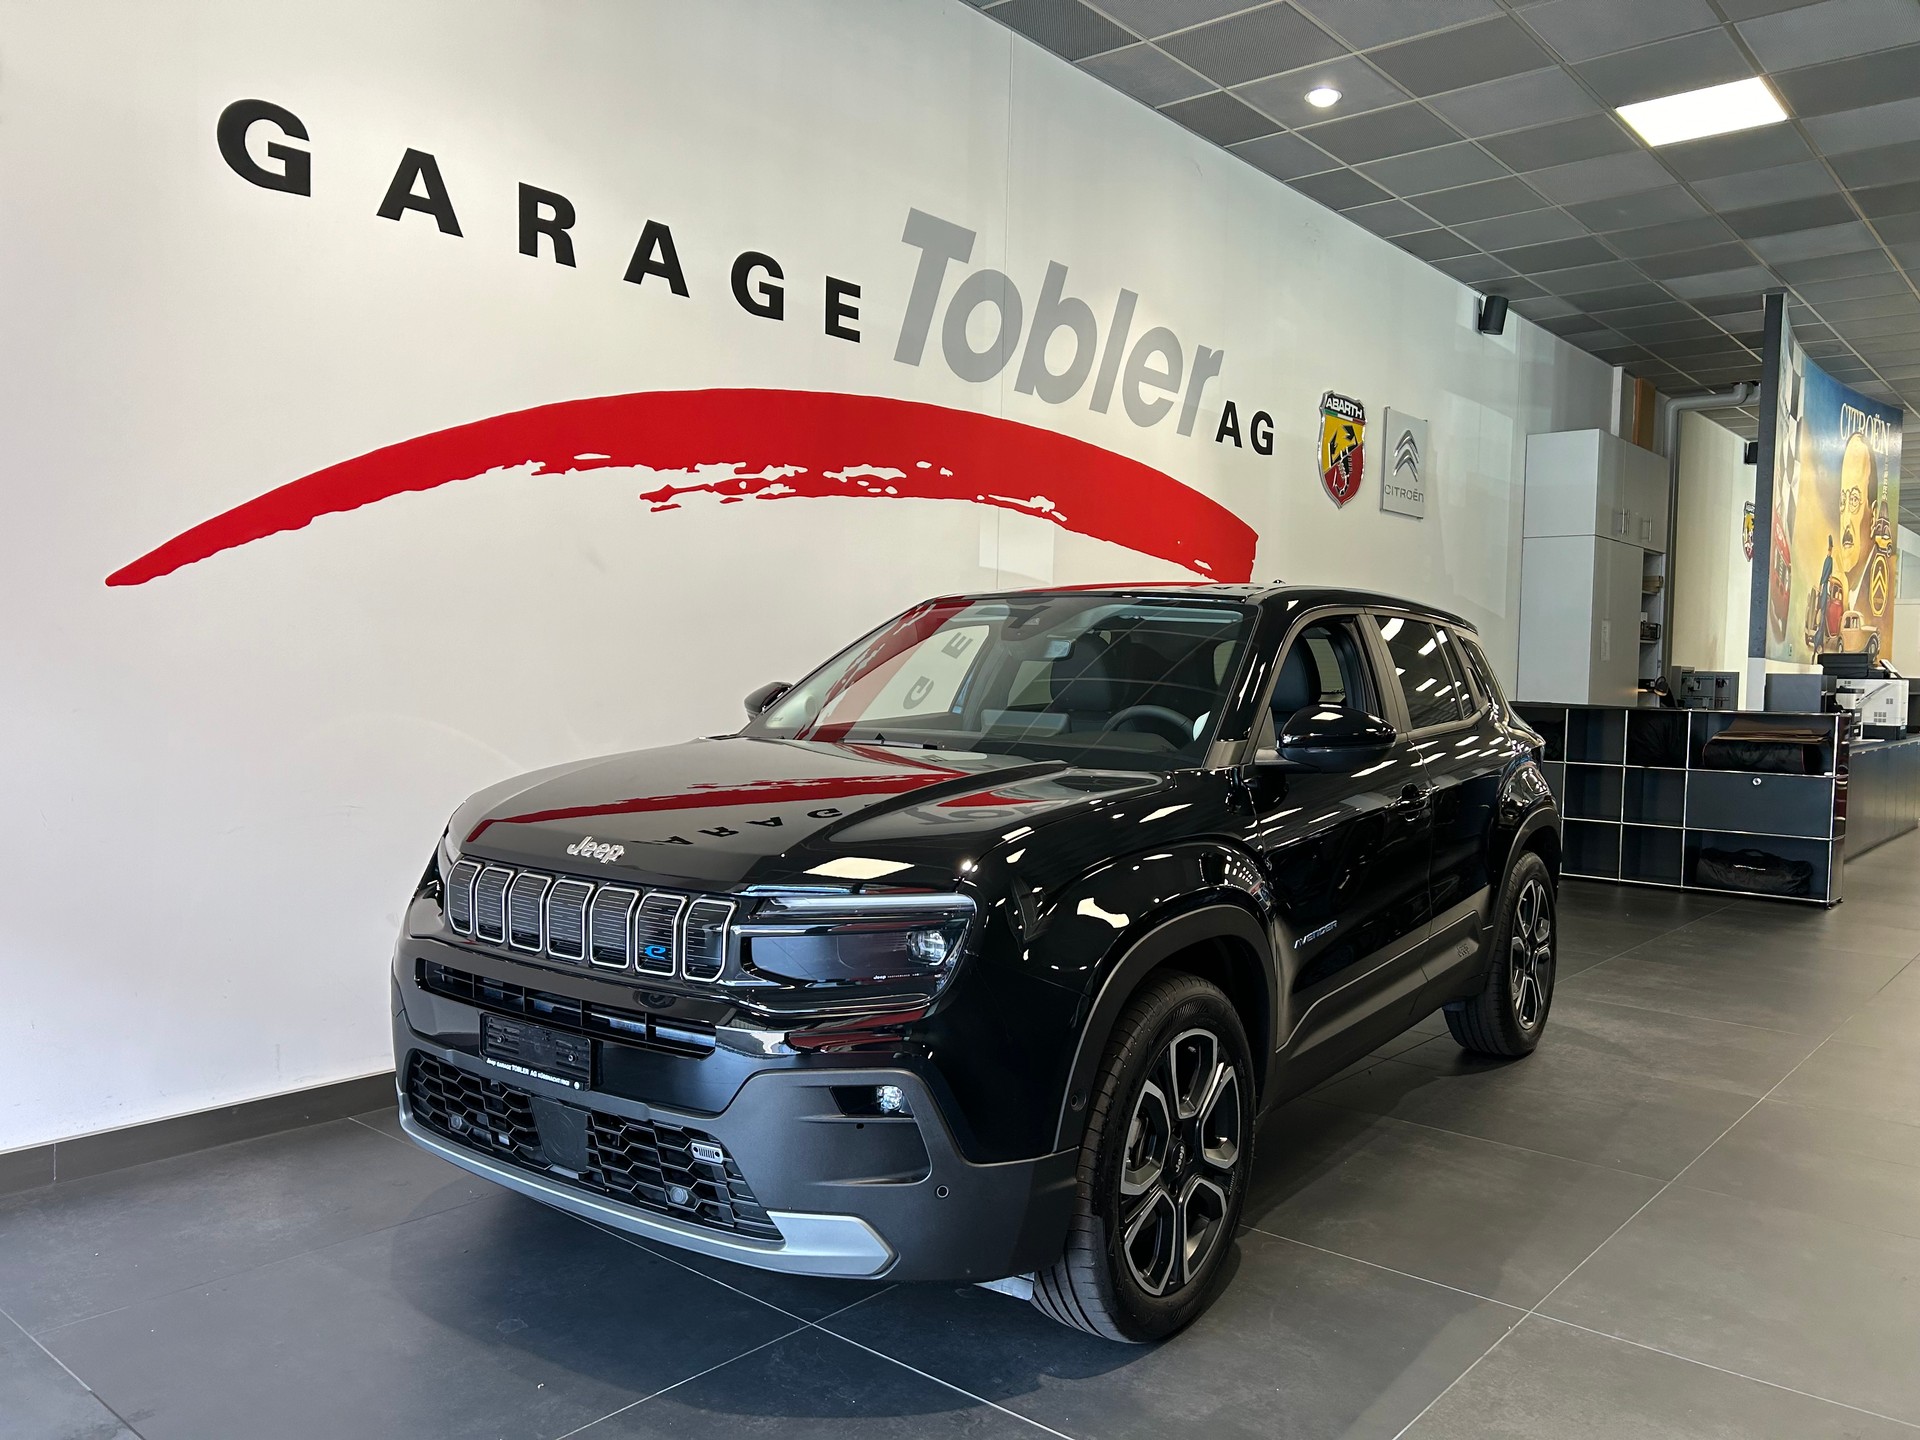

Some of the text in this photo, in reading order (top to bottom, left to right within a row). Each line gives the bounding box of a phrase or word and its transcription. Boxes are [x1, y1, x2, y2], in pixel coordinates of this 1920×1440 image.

[216, 98, 1275, 456] GARAGE Tobler AG
[1326, 398, 1363, 418] ABARTH
[1840, 402, 1891, 456] CITROËN
[566, 836, 625, 864] Jeep
